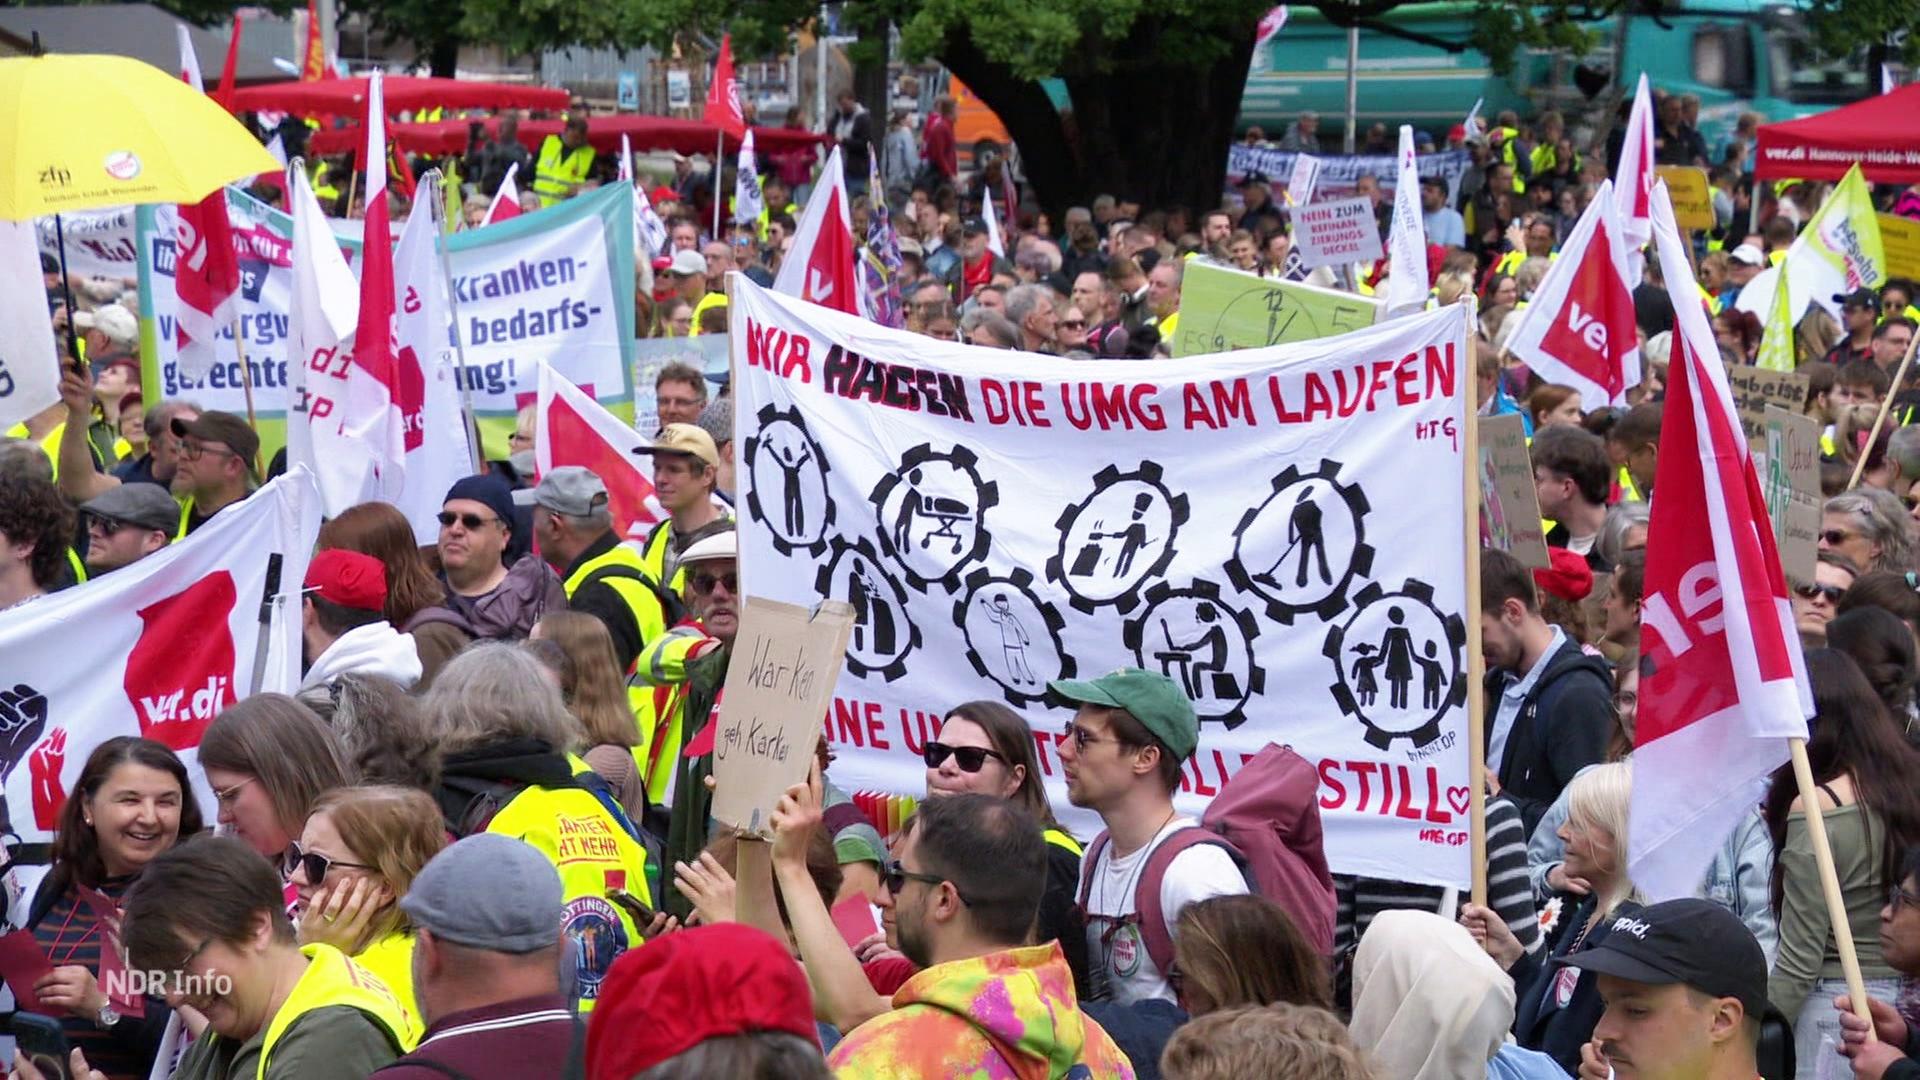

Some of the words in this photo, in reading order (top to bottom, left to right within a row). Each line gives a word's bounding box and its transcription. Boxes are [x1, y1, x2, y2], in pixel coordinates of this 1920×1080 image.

[1765, 146, 1805, 160] ver.di
[1300, 210, 1333, 223] NEIN
[1335, 204, 1365, 218] ZUM
[1322, 243, 1360, 256] DECKEL
[1263, 289, 1284, 312] 12
[470, 297, 602, 346] bedarfs-
[745, 316, 812, 384] WIR
[980, 378, 1052, 428] DIE
[1060, 382, 1168, 432] UMG
[1183, 378, 1258, 431] AM
[1268, 341, 1456, 424] LAUFEN
[1415, 416, 1458, 453] HTG
[1317, 757, 1452, 825] STILL
